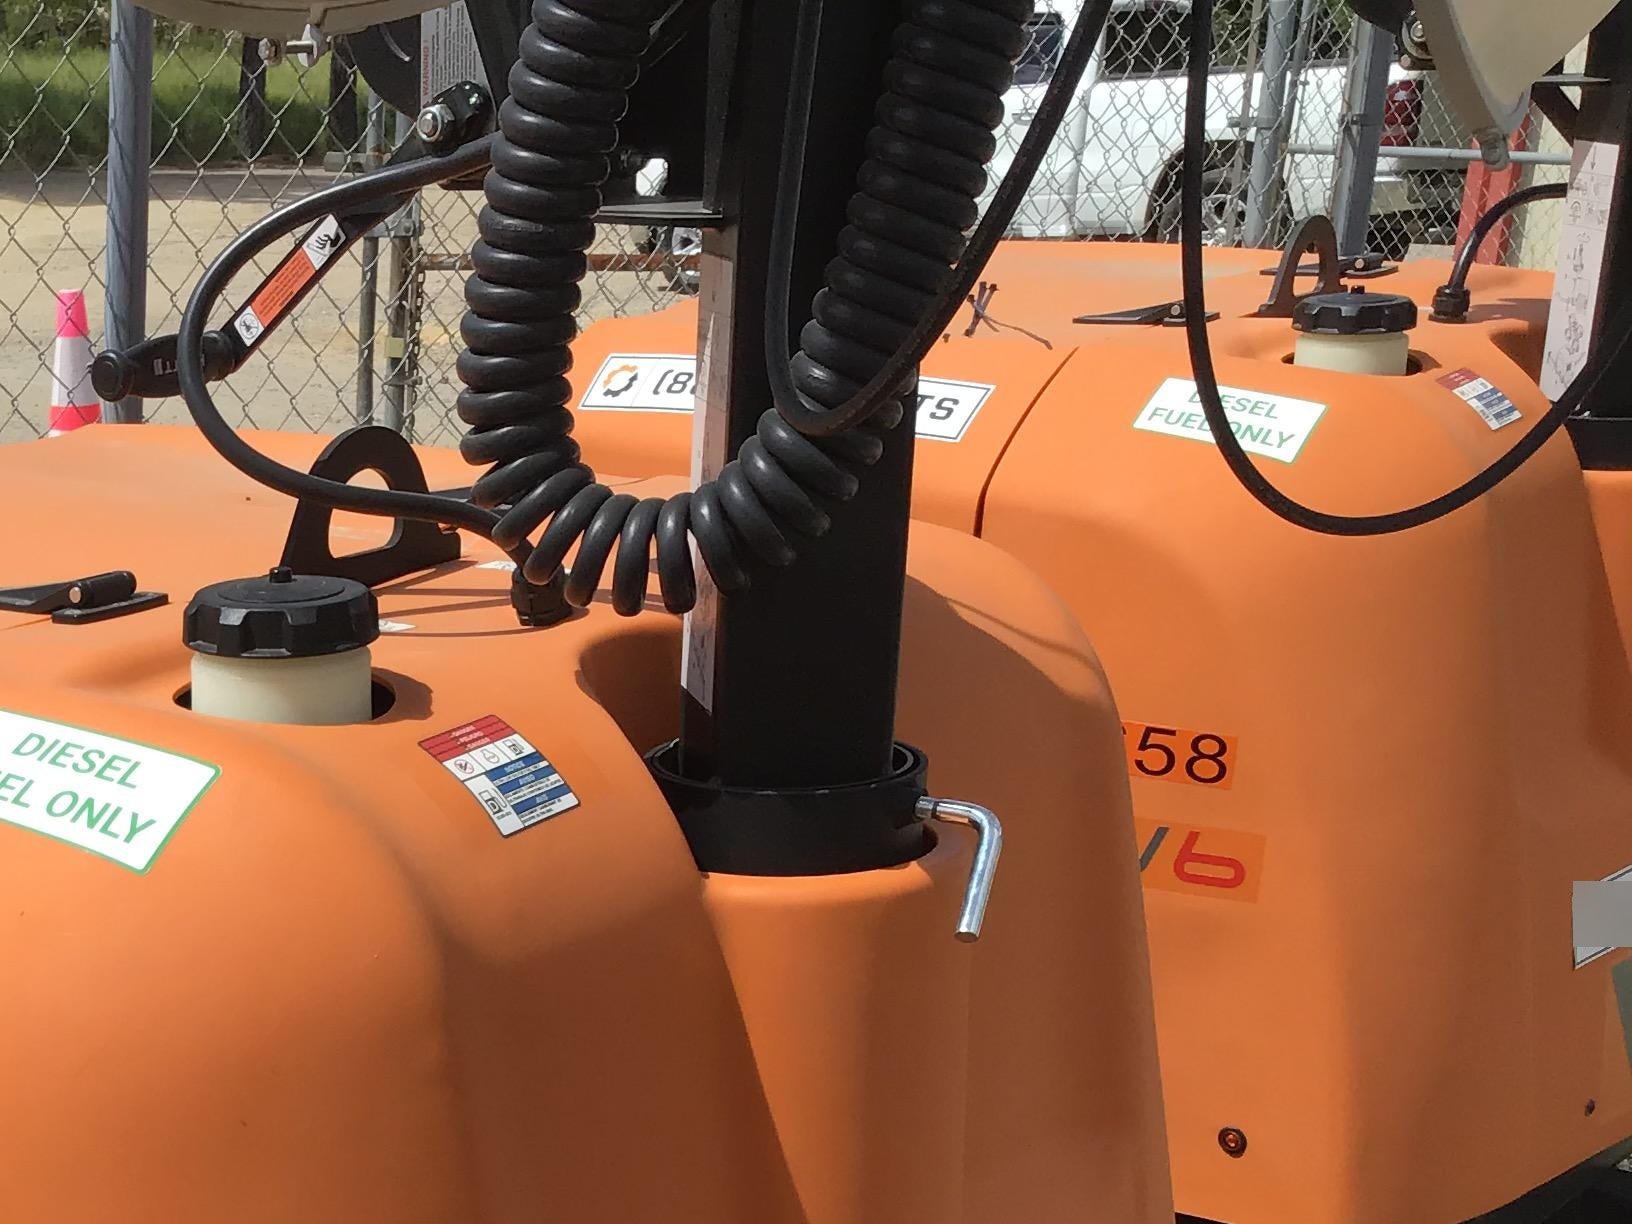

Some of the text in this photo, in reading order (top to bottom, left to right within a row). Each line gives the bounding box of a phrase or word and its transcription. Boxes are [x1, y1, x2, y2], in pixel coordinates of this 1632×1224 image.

[652, 369, 697, 395] (8
[11, 732, 142, 789] DIESEL
[1121, 725, 1228, 784] 58
[45, 790, 157, 844] ONLY
